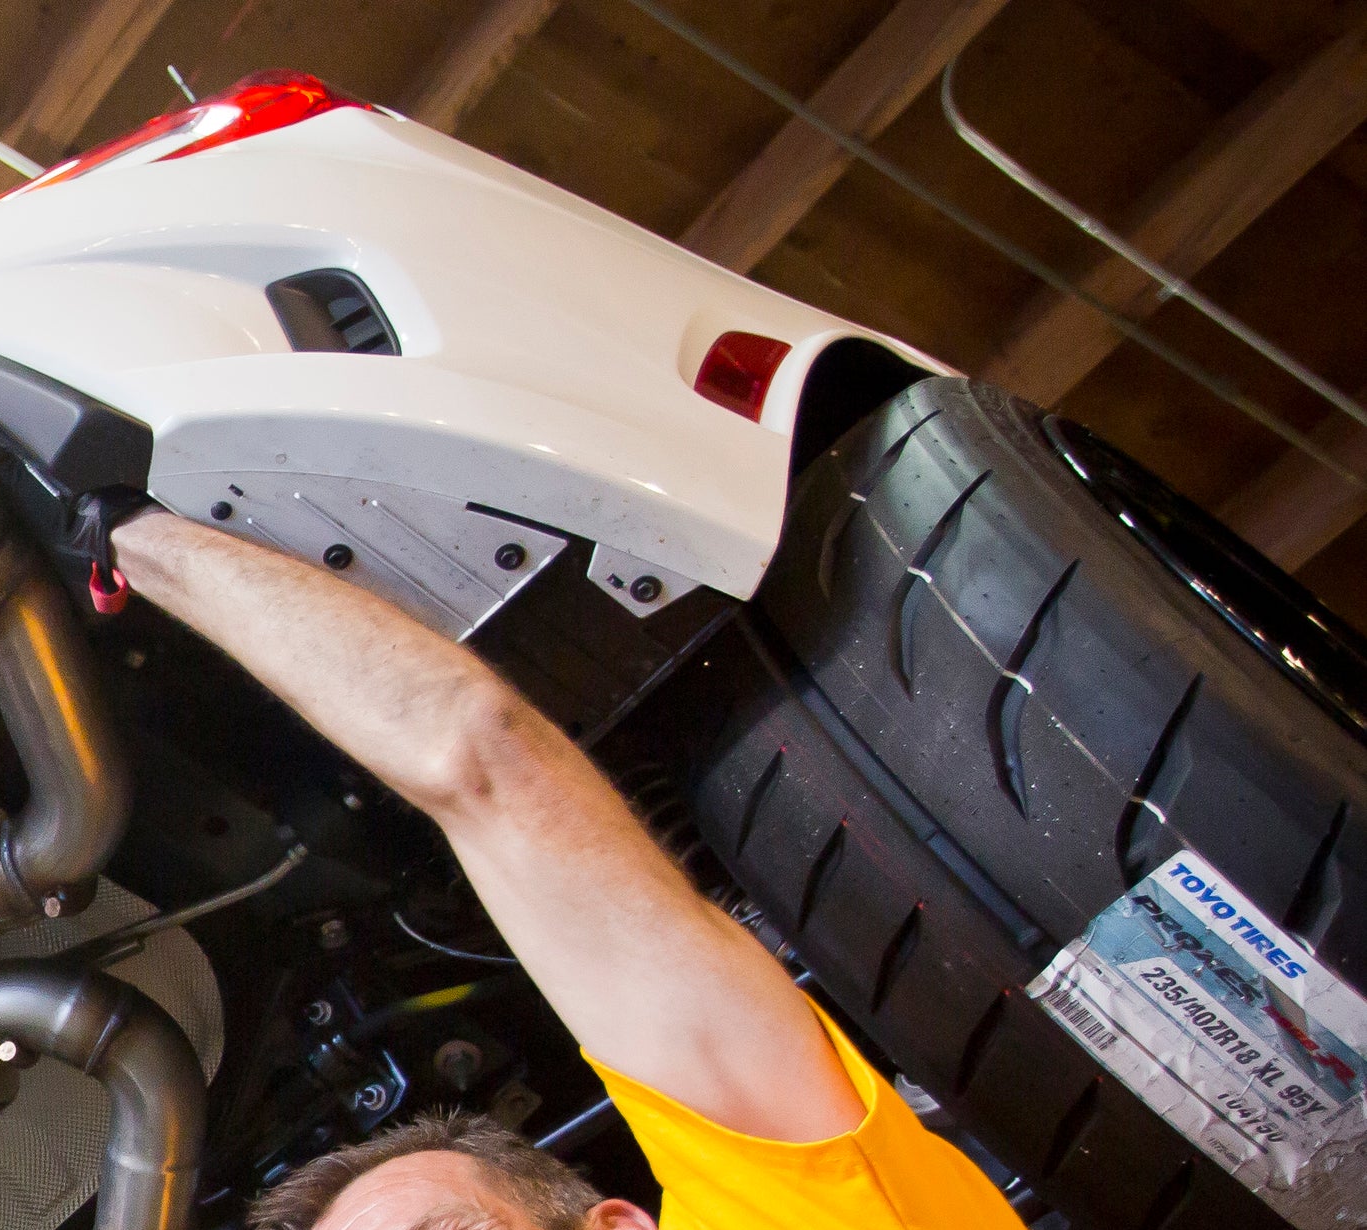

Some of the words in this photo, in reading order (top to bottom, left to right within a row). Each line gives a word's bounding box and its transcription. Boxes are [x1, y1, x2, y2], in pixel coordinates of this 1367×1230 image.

[1168, 862, 1237, 920] TOYO
[1229, 916, 1308, 980] TIRES
[1140, 966, 1261, 1066] 235/40ZR18
[1251, 1057, 1285, 1089] XL
[1278, 1084, 1328, 1117] 95Y
